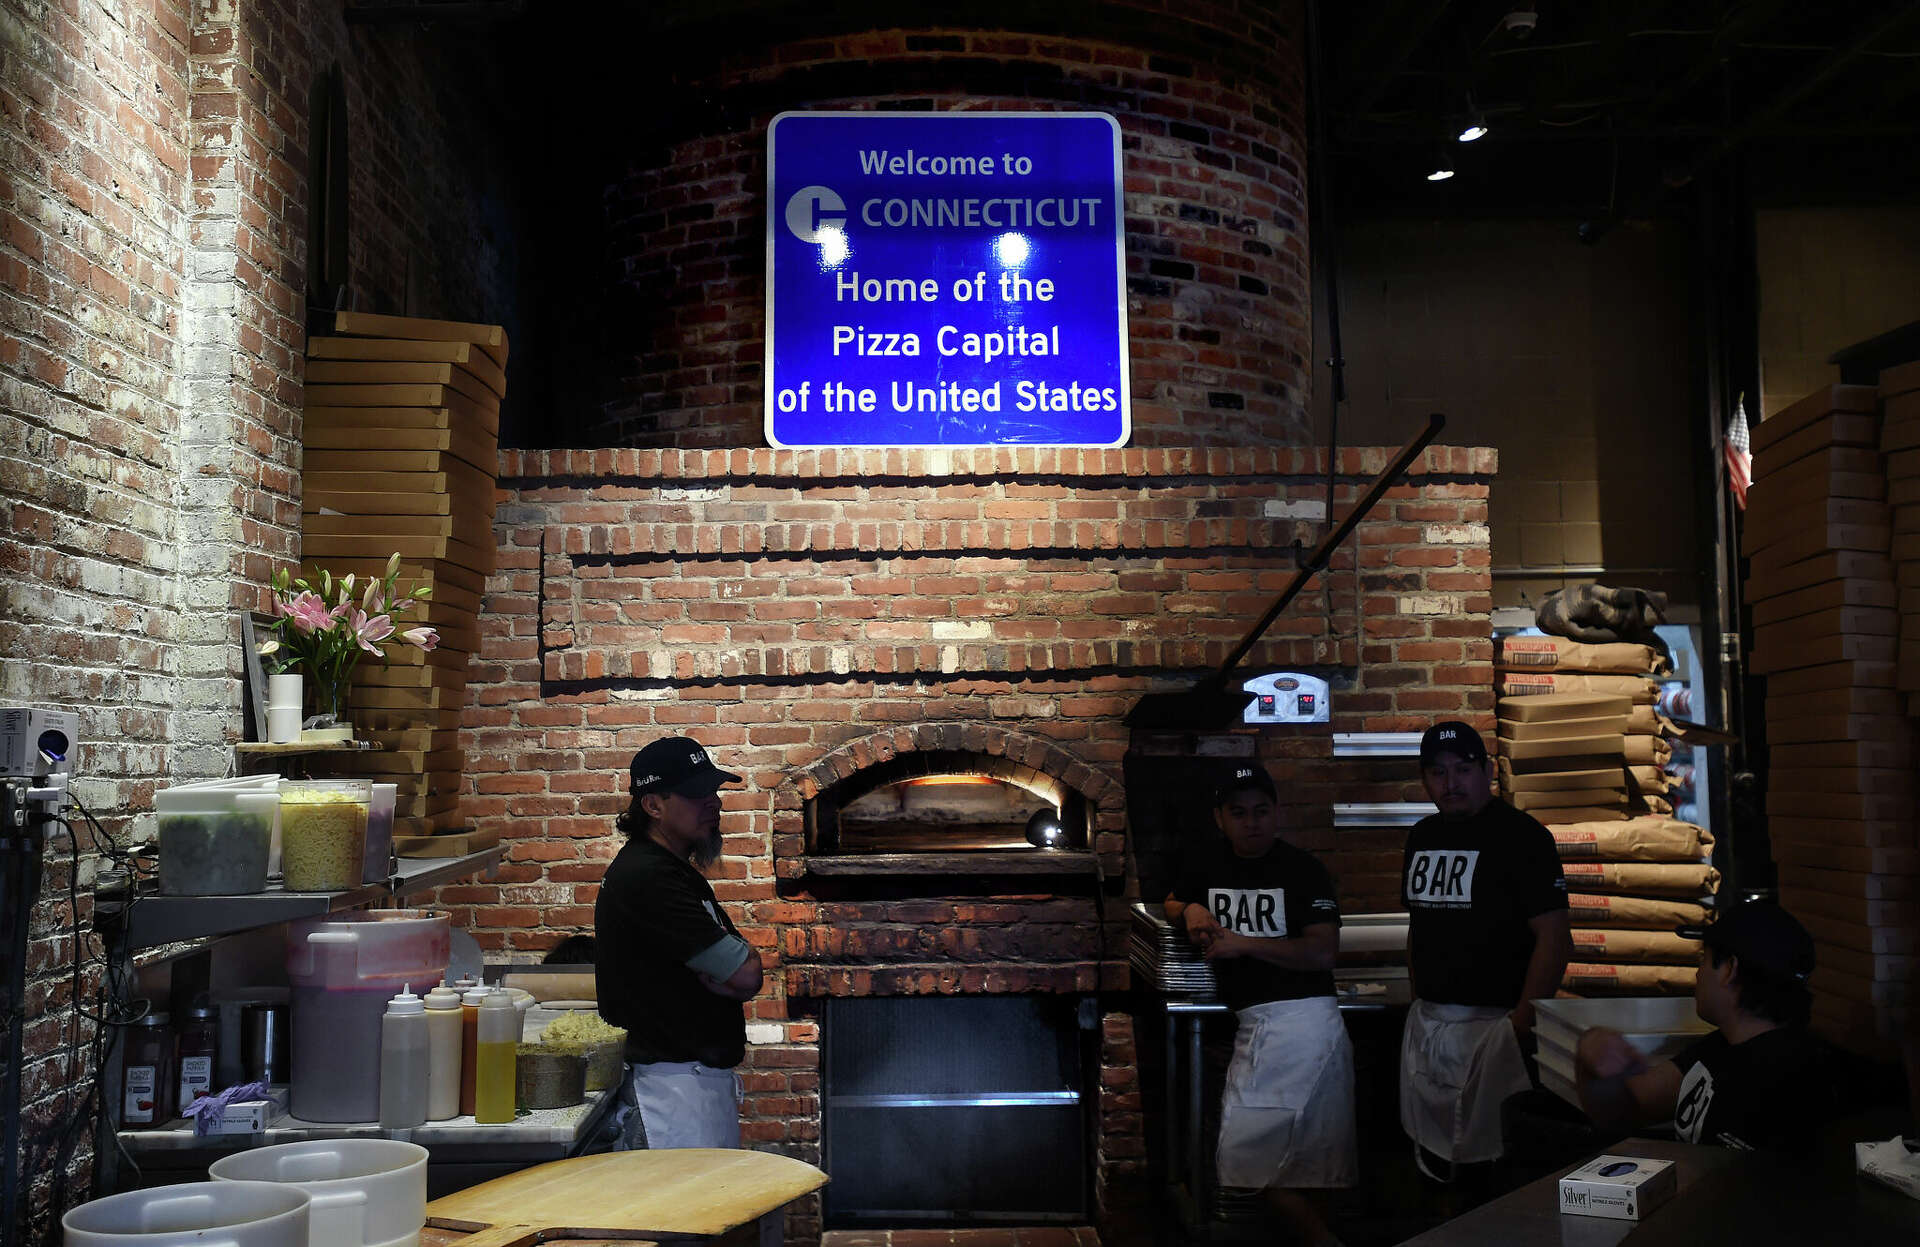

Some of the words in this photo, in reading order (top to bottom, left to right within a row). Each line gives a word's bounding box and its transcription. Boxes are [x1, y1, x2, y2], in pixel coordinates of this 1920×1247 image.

[859, 150, 994, 175] Welcome
[1002, 153, 1033, 175] to
[861, 198, 1102, 227] CONNECTICUT
[836, 271, 939, 302] Home
[953, 271, 986, 302] of
[998, 271, 1055, 302] the
[833, 325, 920, 356] Pizza
[936, 325, 1060, 363] Capital
[777, 381, 810, 413] of
[822, 381, 877, 412] the
[891, 381, 1001, 412] United
[1015, 380, 1117, 412] States
[1439, 730, 1457, 740] BAR
[1236, 768, 1253, 778] BAR
[1412, 855, 1464, 896] BAR
[1214, 893, 1278, 932] BAR
[1563, 1186, 1587, 1205] Silver
